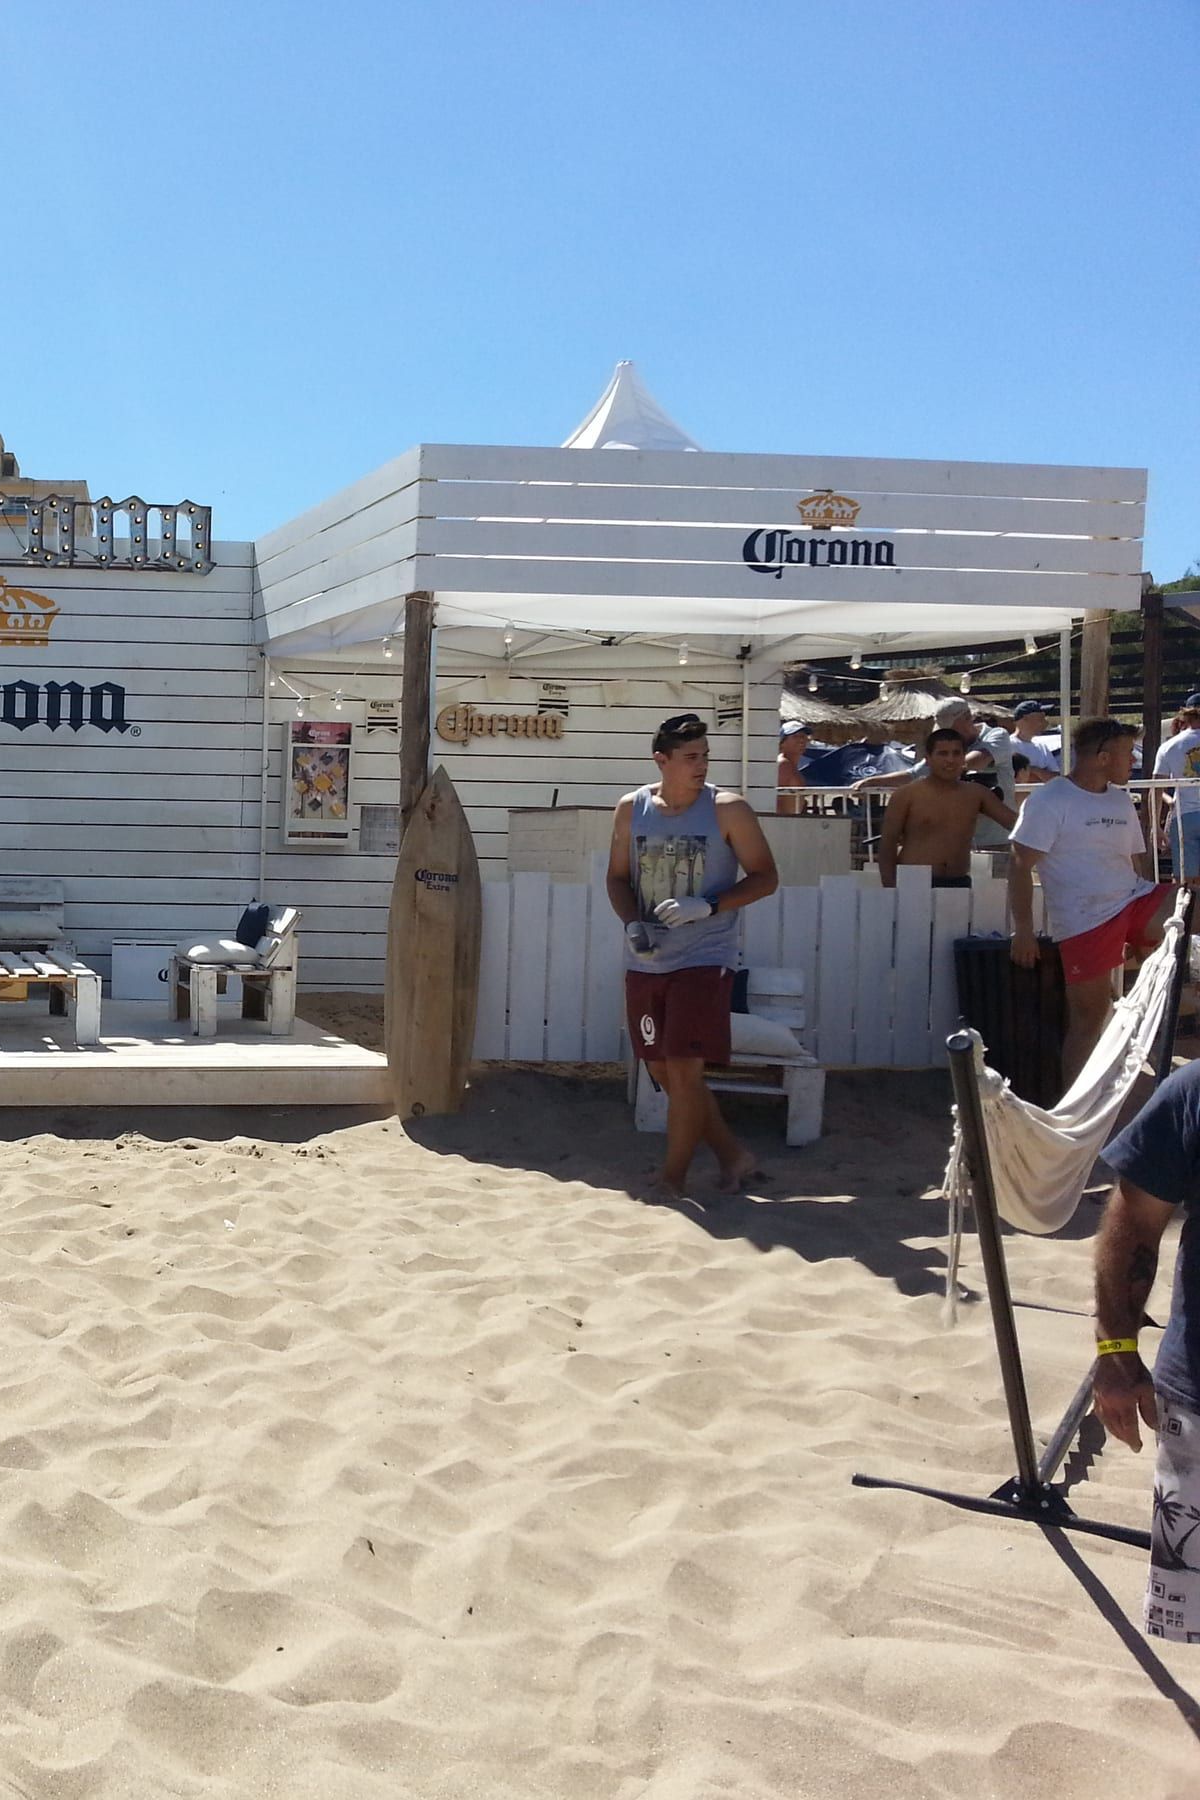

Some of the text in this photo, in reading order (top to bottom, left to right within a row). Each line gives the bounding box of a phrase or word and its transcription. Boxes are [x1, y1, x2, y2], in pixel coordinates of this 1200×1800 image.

[743, 529, 897, 580] Corona
[436, 704, 565, 746] Corona
[415, 868, 459, 883] Corona
[426, 881, 450, 891] Extra
